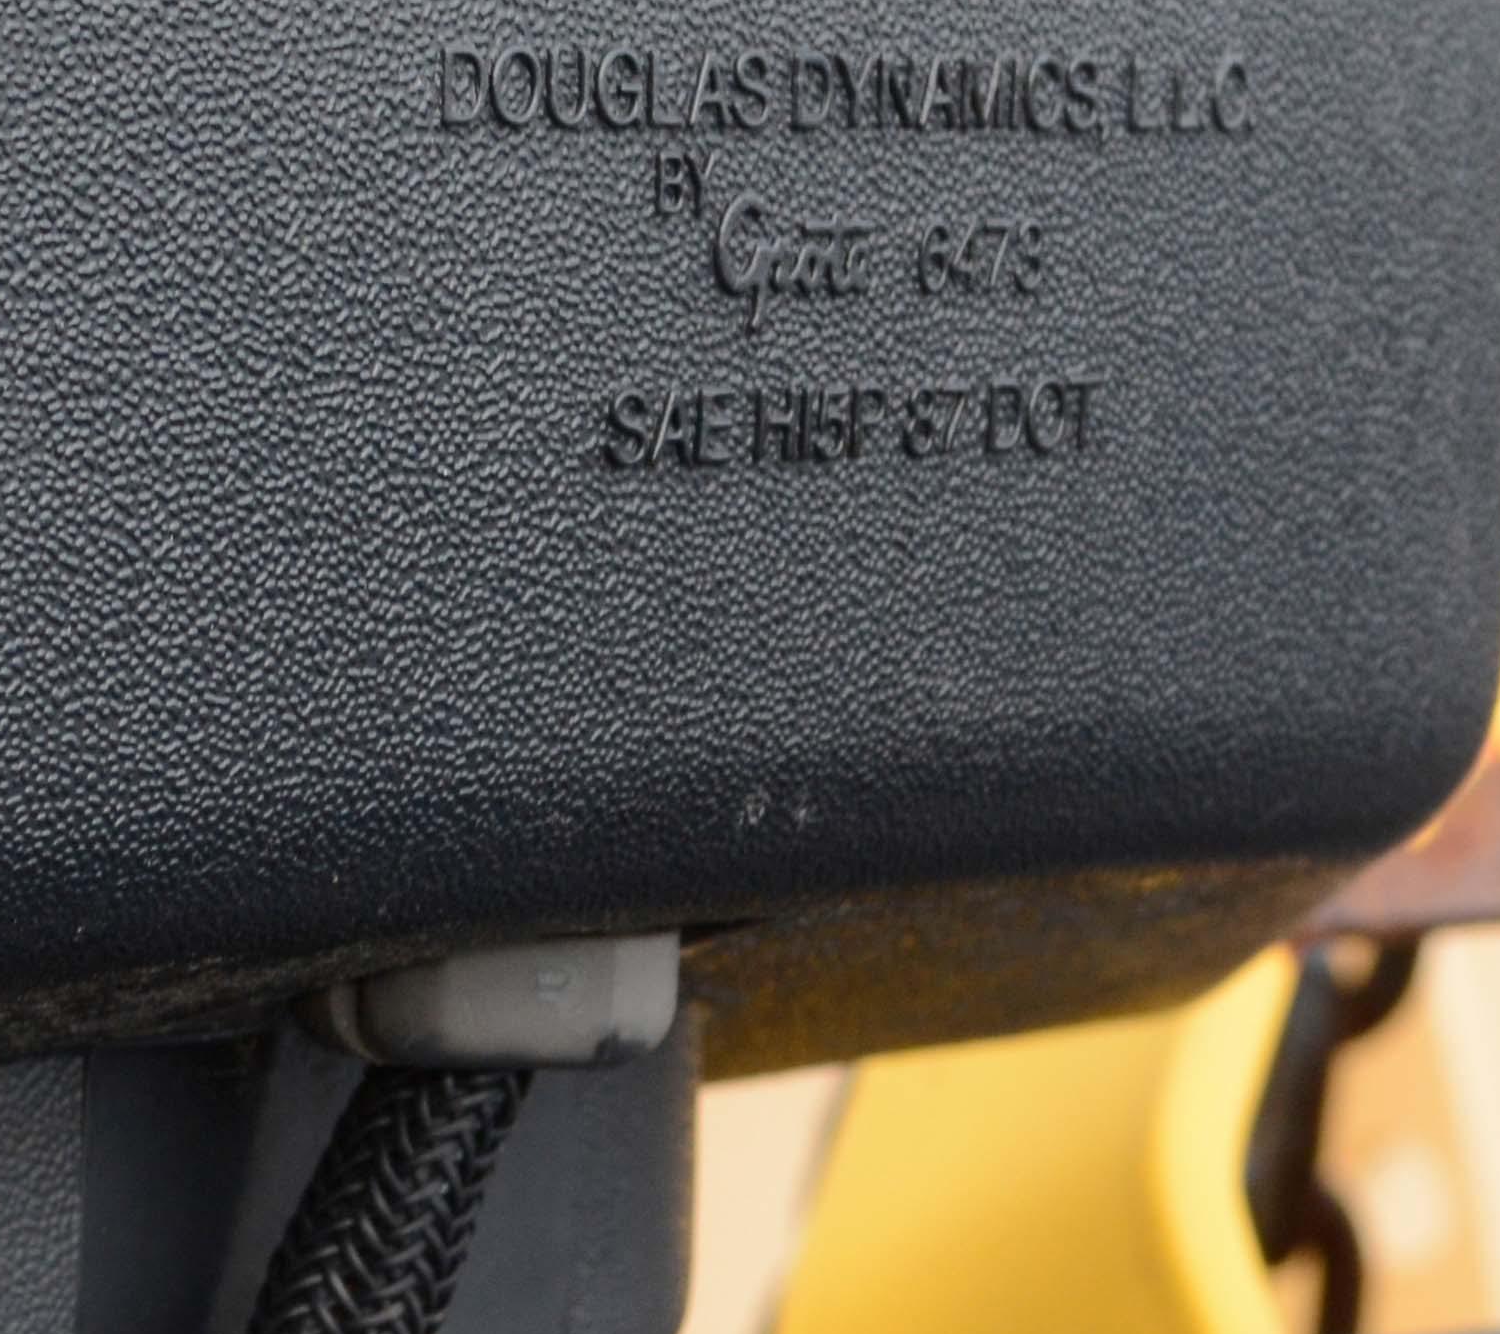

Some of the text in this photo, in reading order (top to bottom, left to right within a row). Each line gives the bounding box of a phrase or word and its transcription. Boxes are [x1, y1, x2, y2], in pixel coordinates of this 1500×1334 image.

[438, 44, 773, 131] DOUGLAS
[654, 151, 716, 215] BY
[603, 387, 732, 467] SAE
[985, 375, 1106, 453] DOT
